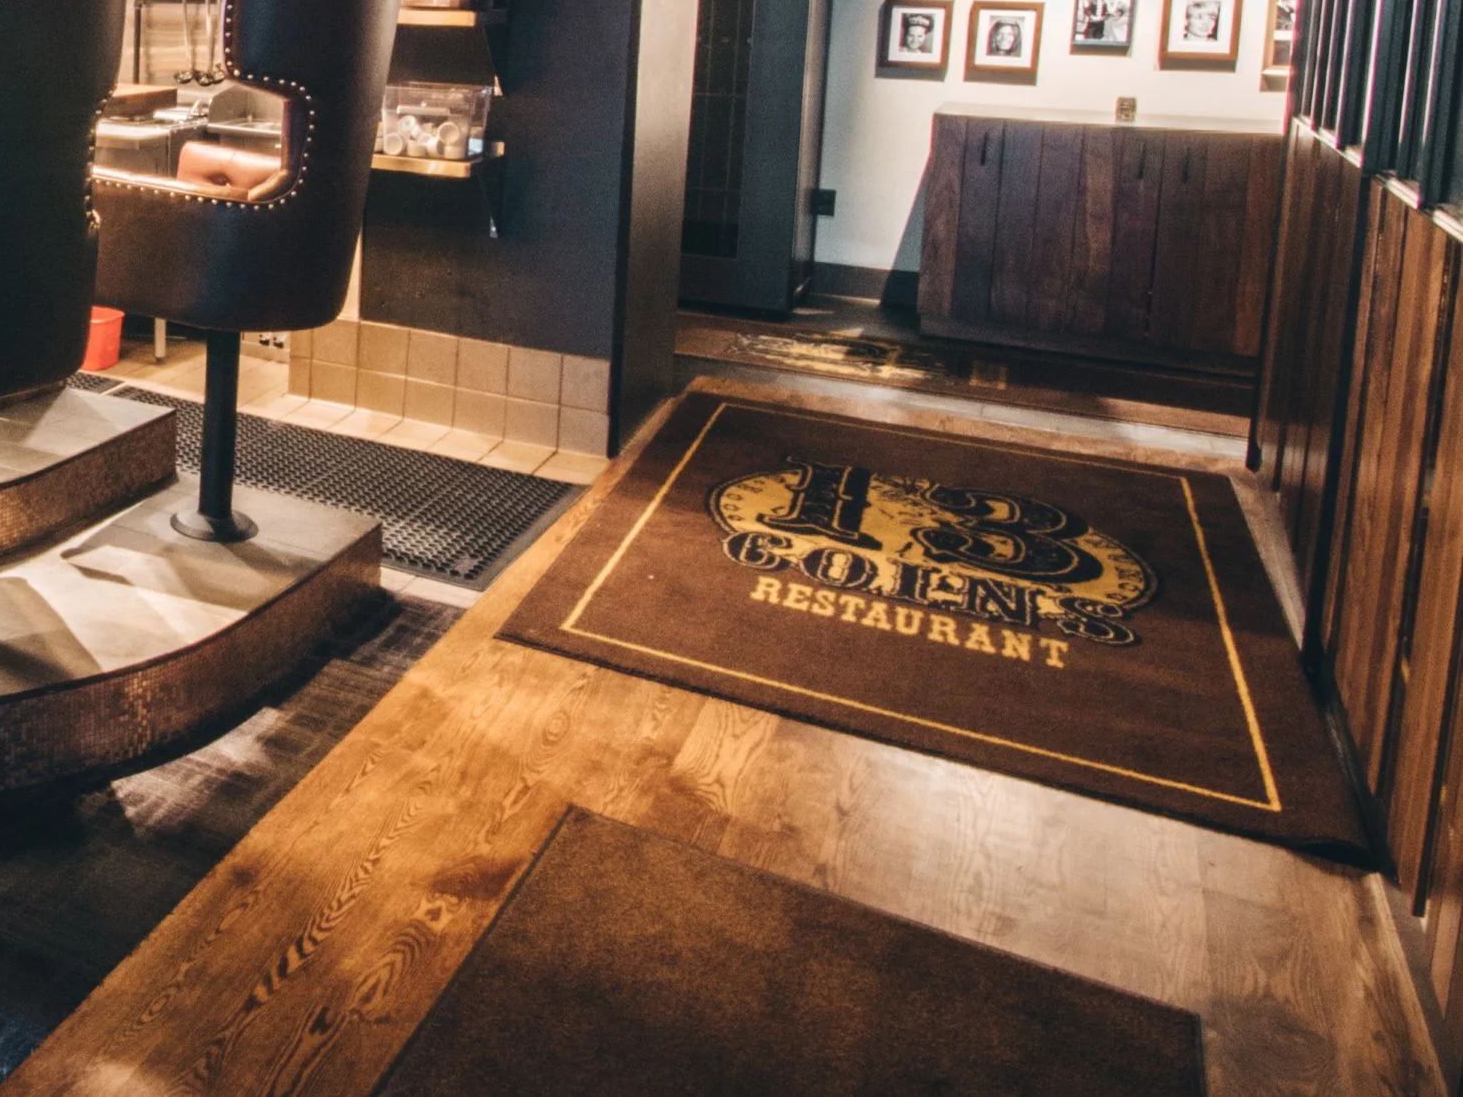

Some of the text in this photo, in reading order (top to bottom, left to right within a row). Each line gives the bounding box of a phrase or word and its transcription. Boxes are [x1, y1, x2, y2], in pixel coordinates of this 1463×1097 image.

[756, 456, 1104, 586] 13
[722, 531, 1142, 646] COINS
[749, 576, 1069, 668] RESTAURANT
